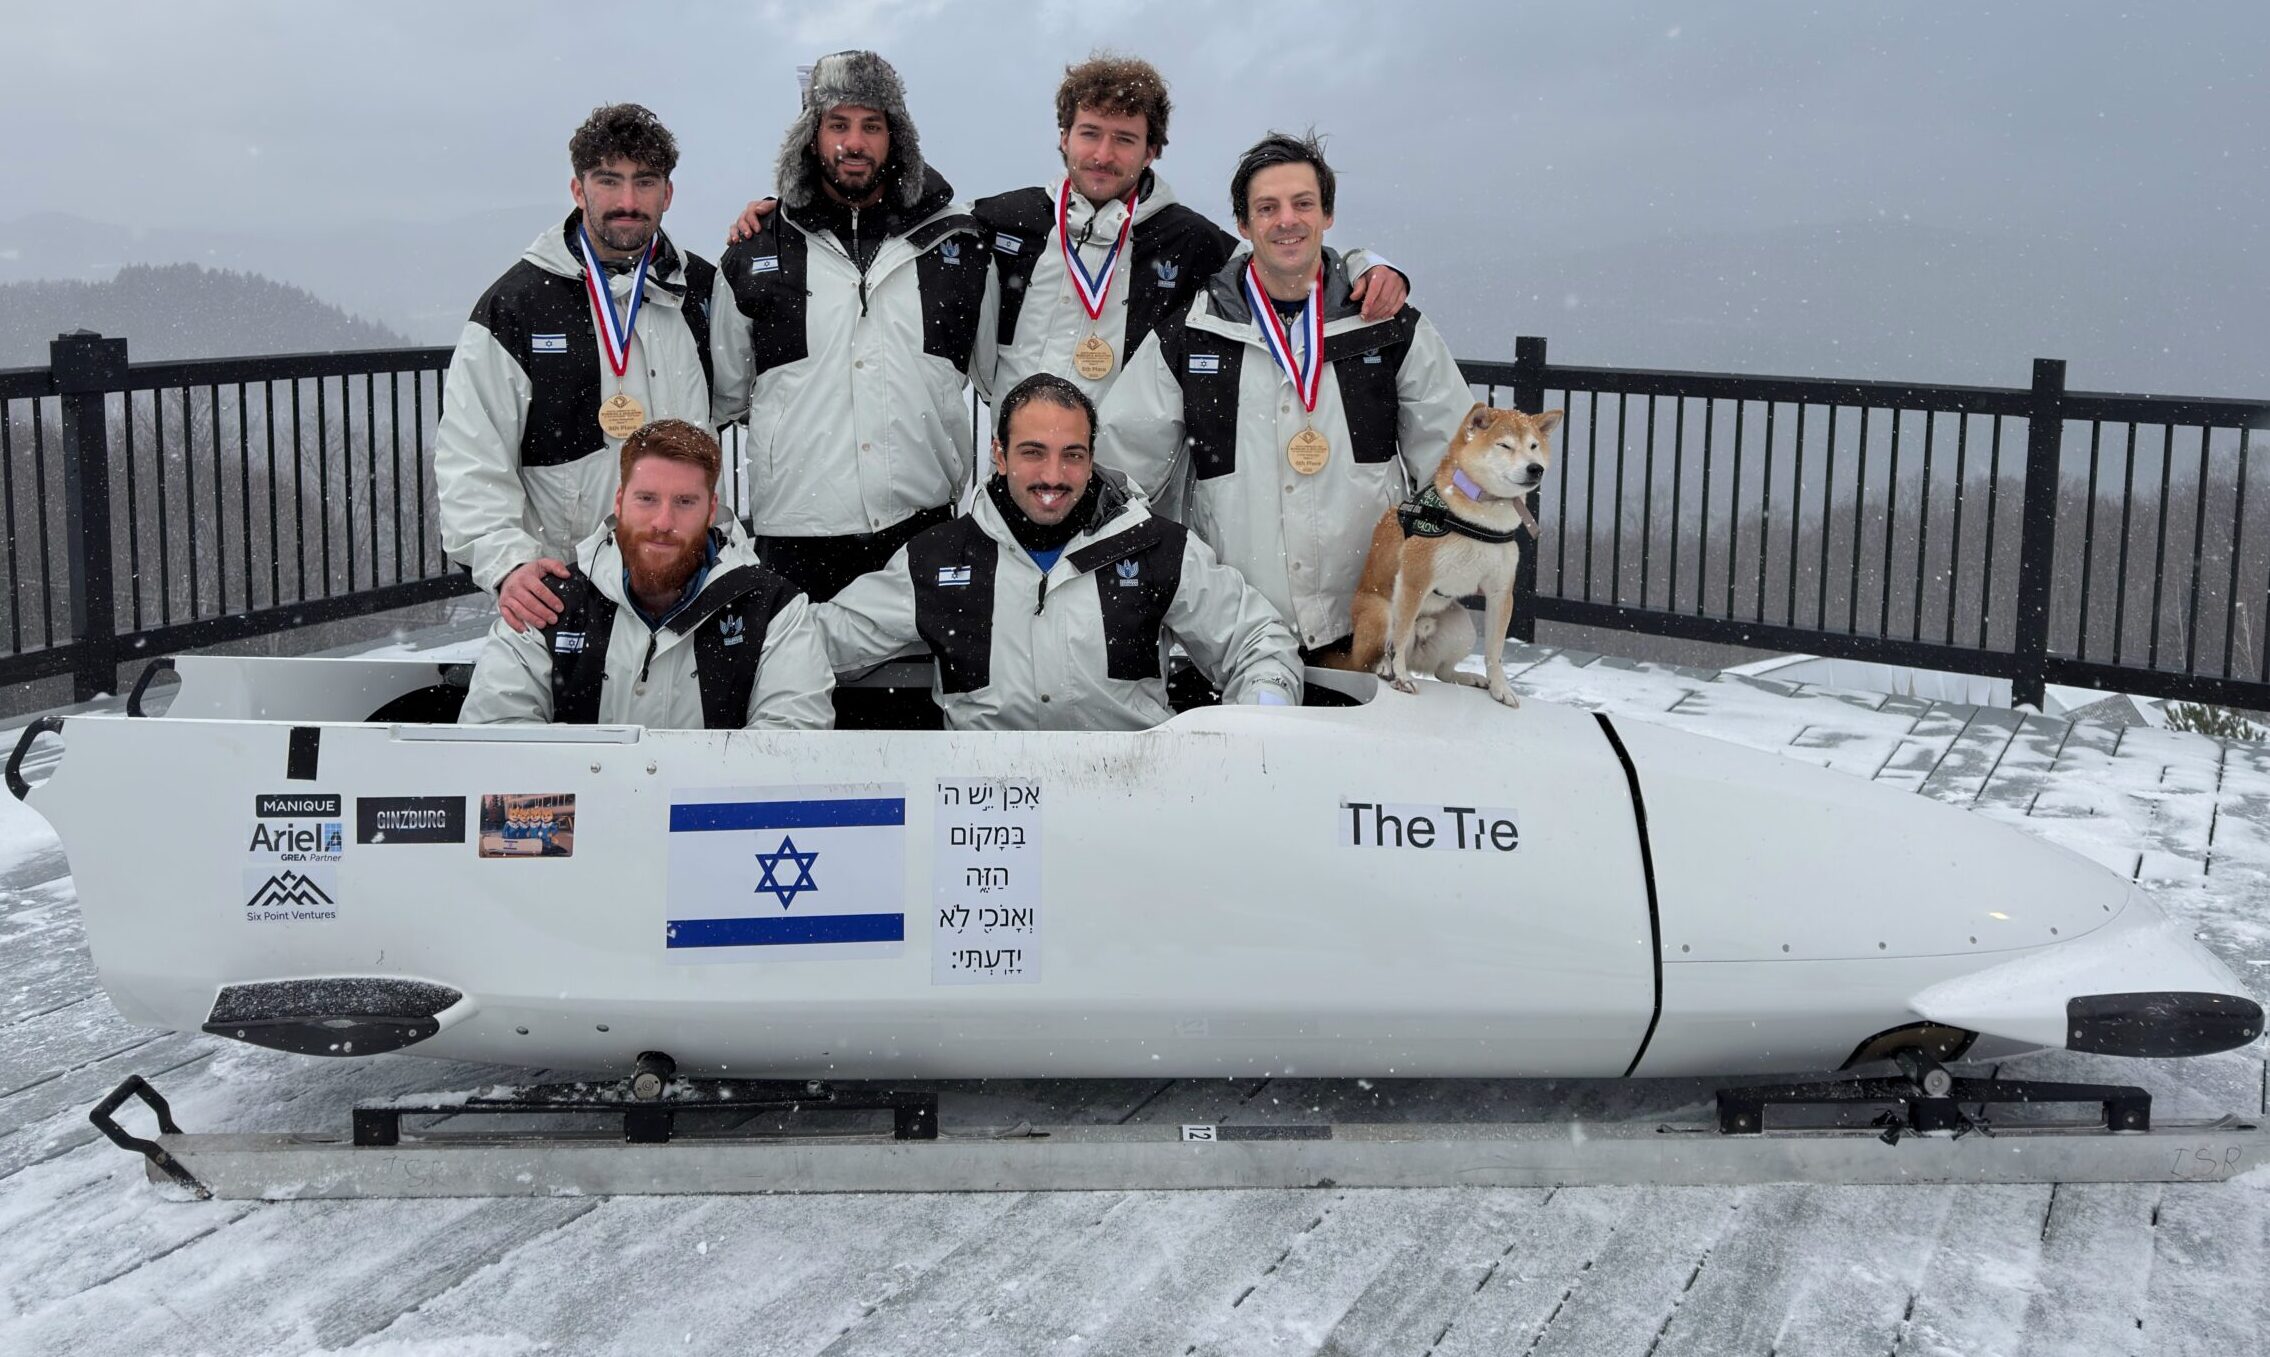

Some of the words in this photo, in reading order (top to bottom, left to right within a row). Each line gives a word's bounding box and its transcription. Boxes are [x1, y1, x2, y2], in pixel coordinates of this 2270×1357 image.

[264, 800, 336, 812] MANIQUE
[376, 810, 446, 829] GINZBURG
[1340, 803, 1435, 848] The
[249, 823, 322, 852] Ariel
[281, 853, 307, 862] GREA
[310, 853, 342, 862] Partner
[247, 912, 262, 921] Six
[264, 911, 289, 921] Point
[291, 910, 336, 920] Ventures
[1188, 1126, 1212, 1140] 12
[2169, 1145, 2242, 1180] ISR
